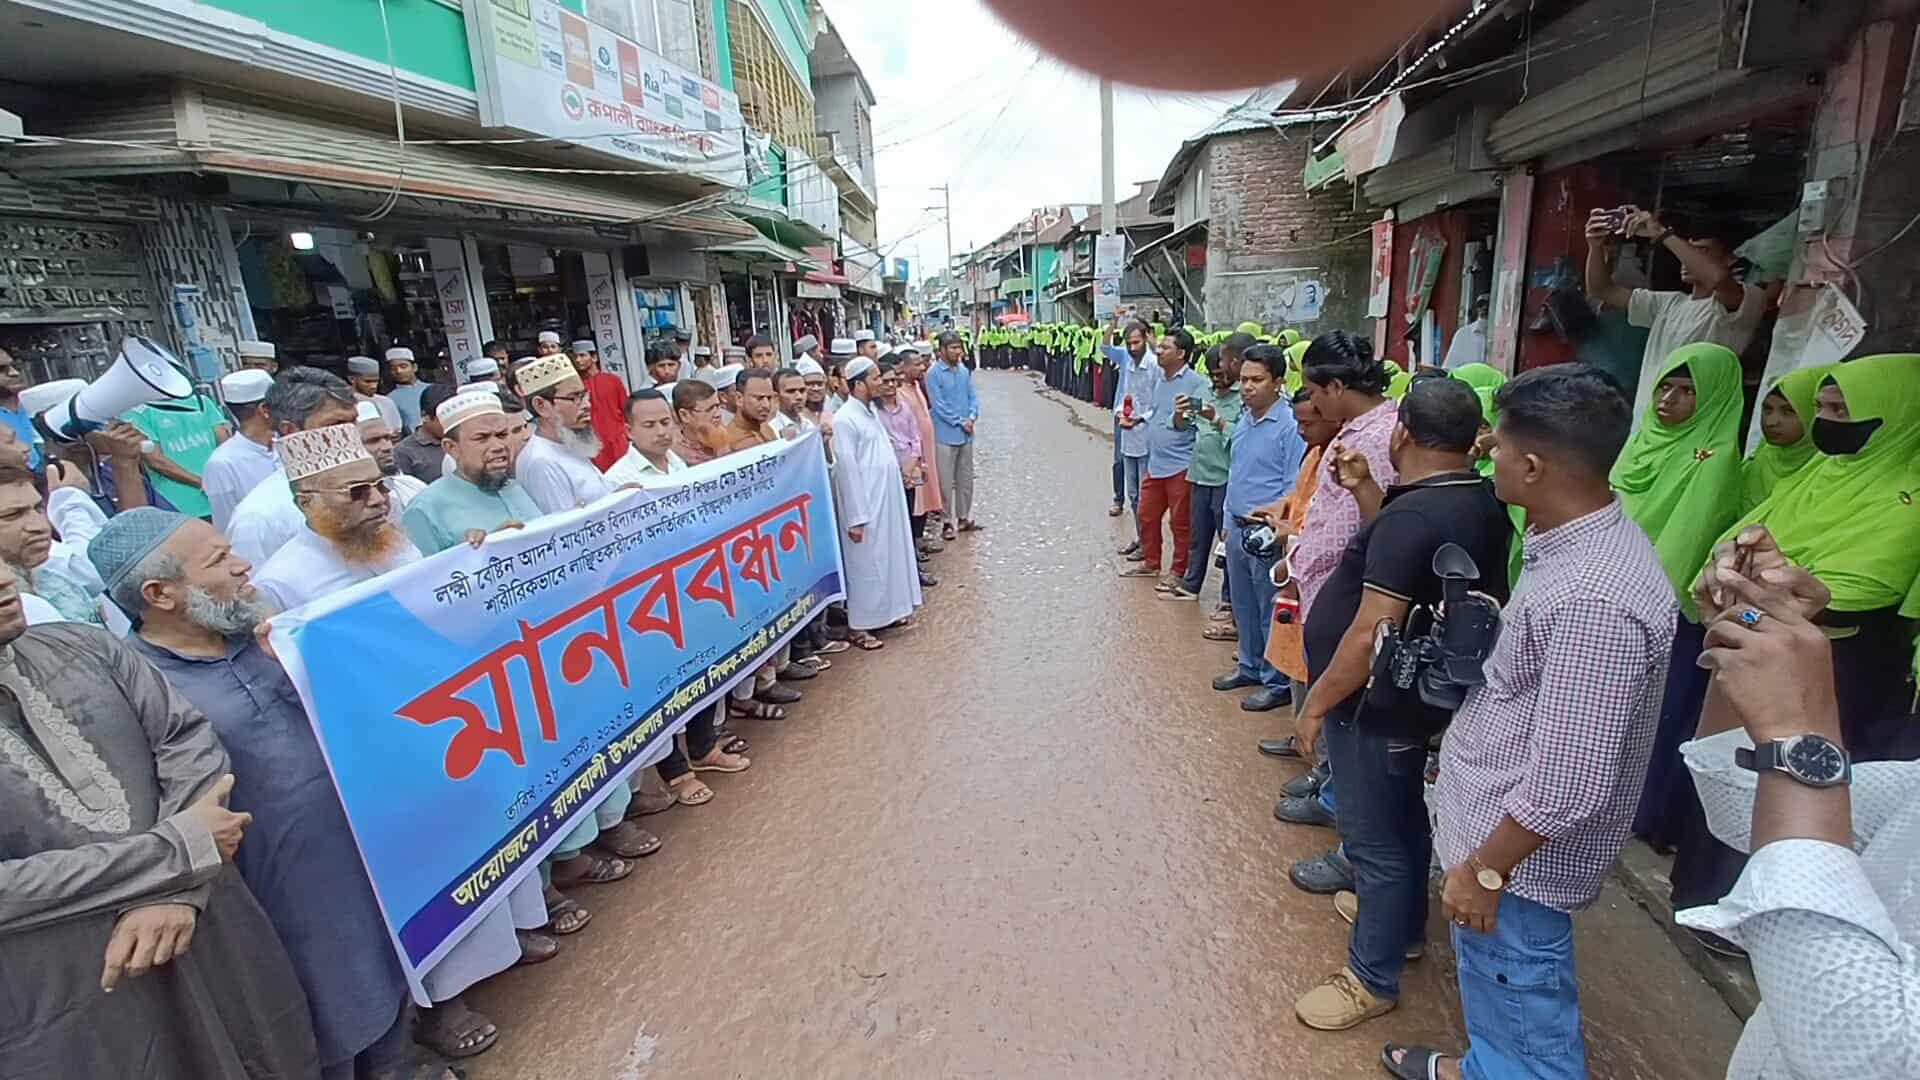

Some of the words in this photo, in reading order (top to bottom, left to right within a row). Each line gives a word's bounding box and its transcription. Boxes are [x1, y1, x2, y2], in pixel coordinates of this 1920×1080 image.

[644, 72, 660, 94] Ria
[518, 533, 557, 566] আদর্শ
[560, 520, 606, 550] মাধ্যমিক
[484, 564, 566, 616] শারীরিকভাবে
[394, 493, 812, 779] মানববন্ধন
[450, 818, 538, 905] আয়োজনে
